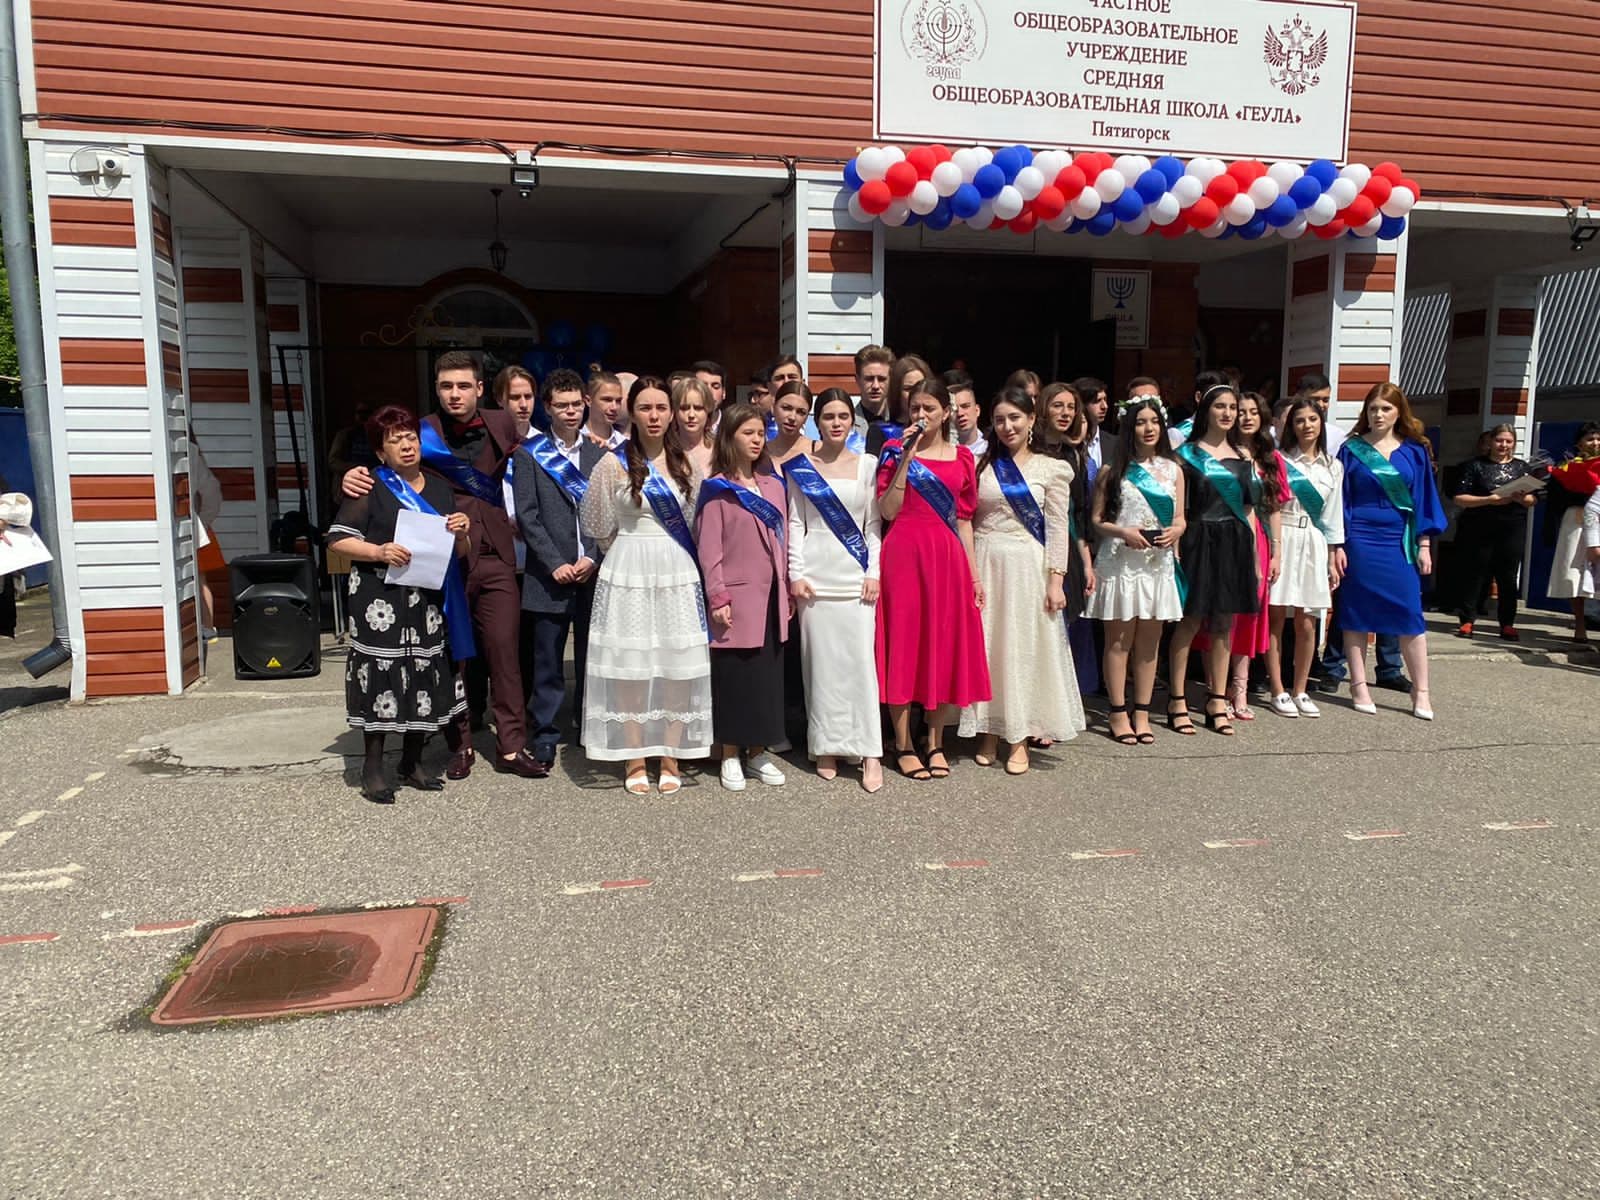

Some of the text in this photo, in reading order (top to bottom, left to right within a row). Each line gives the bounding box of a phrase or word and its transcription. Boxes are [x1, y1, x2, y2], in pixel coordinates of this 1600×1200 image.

[1014, 11, 1239, 45] ОБЩЕОБРАЗОВАТЕЛЬНОЕ
[1066, 41, 1188, 66] УЧРЕЖДЕНИЕ
[1083, 68, 1165, 90] СРЕДНЯЯ
[932, 84, 1302, 124] ОБЩЕОБРАЗОВАТЕЛЬНАЯ ШКОЛА «ГЕУЛА»
[1092, 120, 1171, 143] Пятигорск
